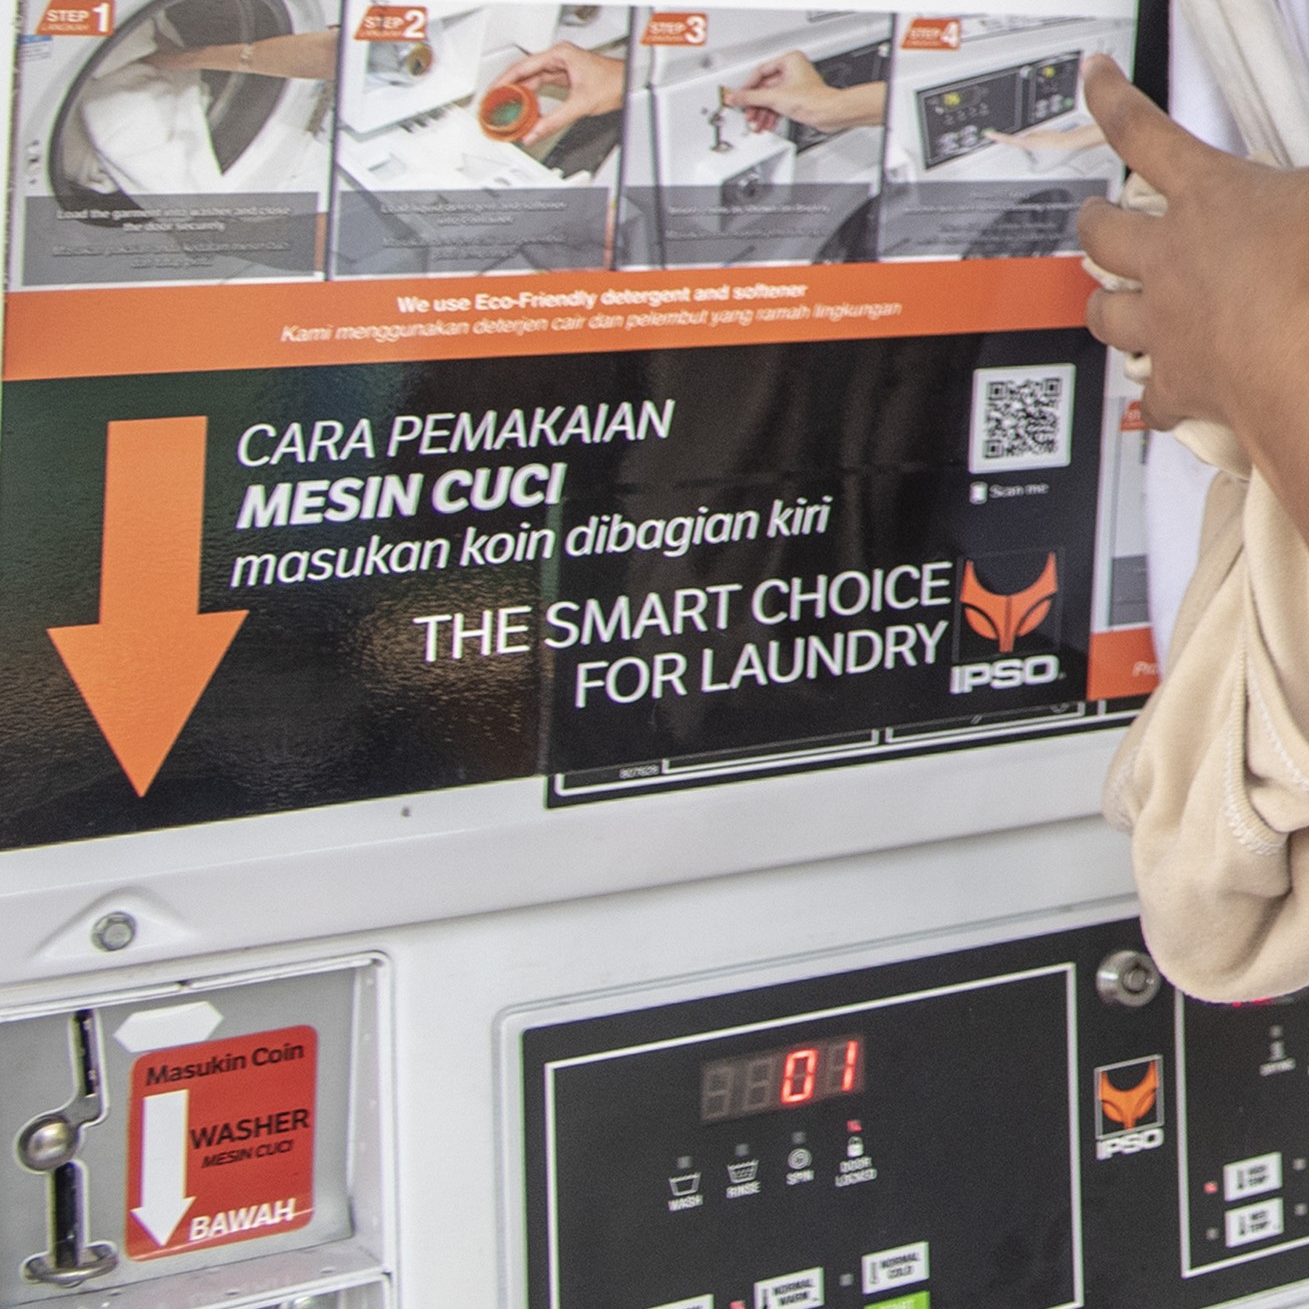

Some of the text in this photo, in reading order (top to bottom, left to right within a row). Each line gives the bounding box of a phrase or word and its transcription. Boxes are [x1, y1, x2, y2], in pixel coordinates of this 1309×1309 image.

[46, 3, 110, 33] STEP 1
[363, 9, 425, 39] STEP 2
[650, 16, 706, 44] STEP 3
[941, 21, 959, 48] 4
[397, 282, 808, 313] We use Eco-Friendly detergent and softener
[281, 324, 332, 343] Kami
[335, 320, 469, 343] menggunakan
[472, 317, 548, 337] deterjen
[551, 314, 585, 331] cair
[588, 312, 623, 329] dan
[709, 308, 754, 327] yang
[813, 300, 902, 322] lingkungan
[236, 398, 676, 468] CARA PEMAKAIAN
[236, 461, 568, 530] MESIN CUCI
[988, 482, 1049, 498] Scan me
[230, 495, 834, 588] masukan koin dibagian kiri
[412, 560, 953, 663] THE SMART CHOICE
[574, 619, 950, 709] FOR LAUNDRY
[950, 655, 1061, 695] IPSO
[145, 1042, 305, 1086] Masukin Coin
[780, 1038, 859, 1106] 01
[189, 1108, 310, 1150] WASHER
[1096, 1127, 1165, 1161] IPSO
[201, 1138, 294, 1168] MESIN CUCI
[189, 1198, 297, 1242] BAWAH
[668, 1194, 704, 1211] WASH
